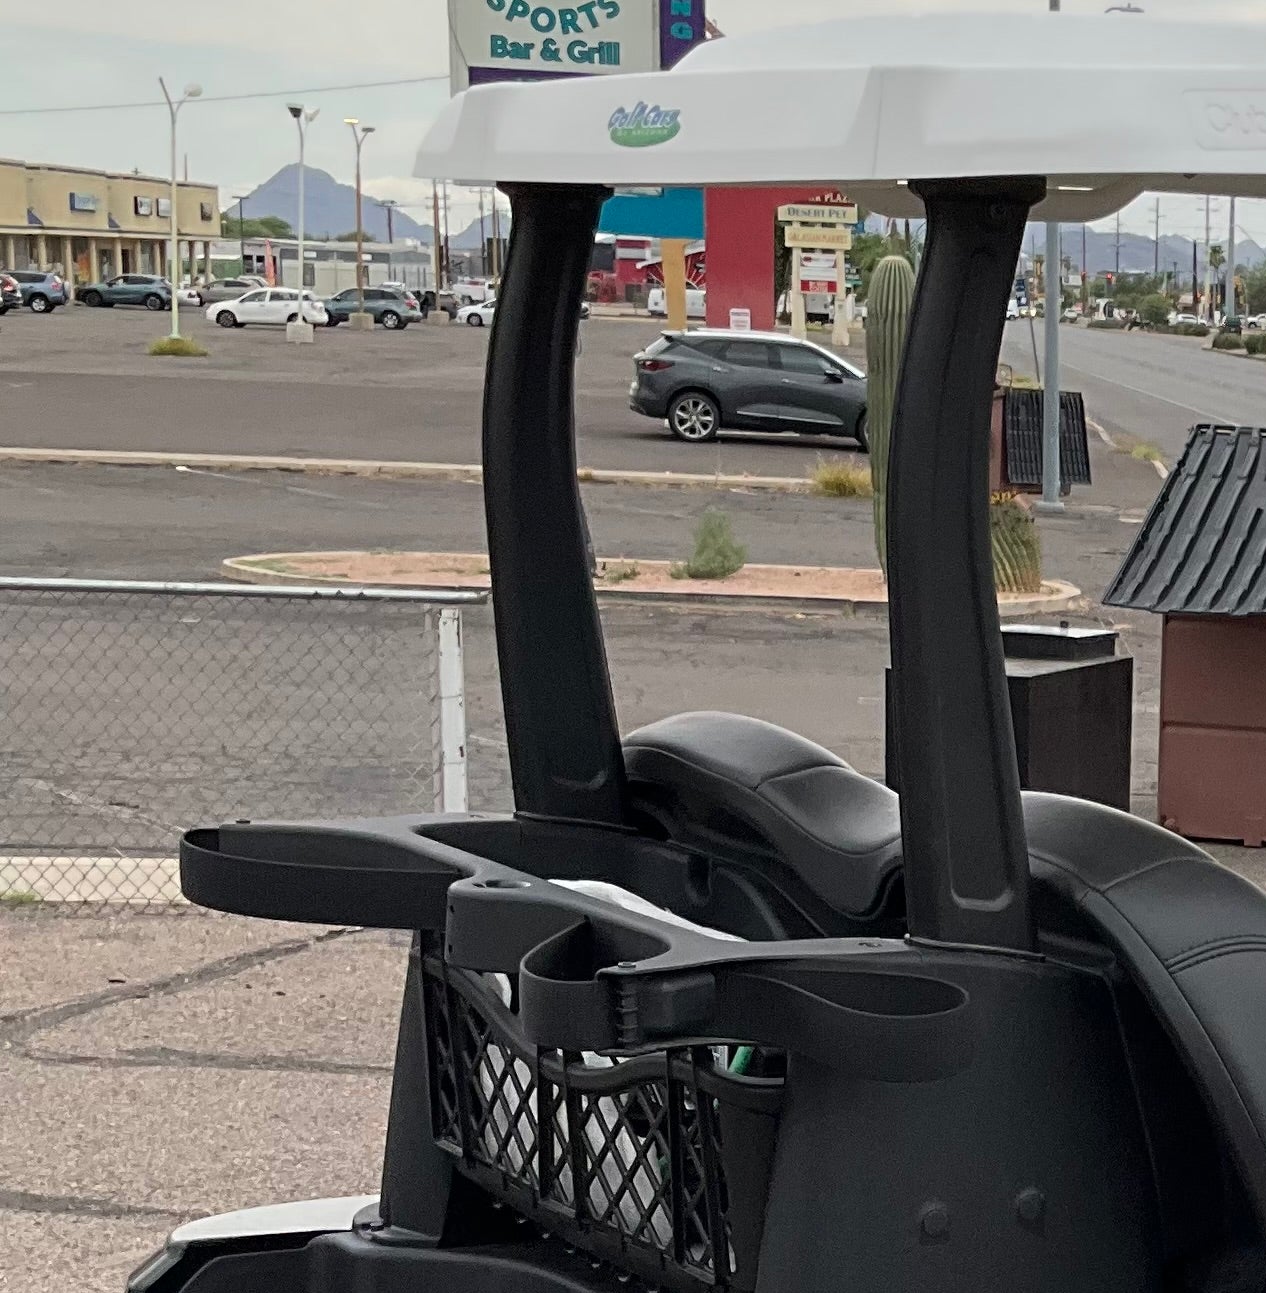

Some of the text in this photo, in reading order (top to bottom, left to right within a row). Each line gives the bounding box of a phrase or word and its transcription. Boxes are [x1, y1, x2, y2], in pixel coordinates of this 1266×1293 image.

[490, 34, 620, 66] Bar & Grill
